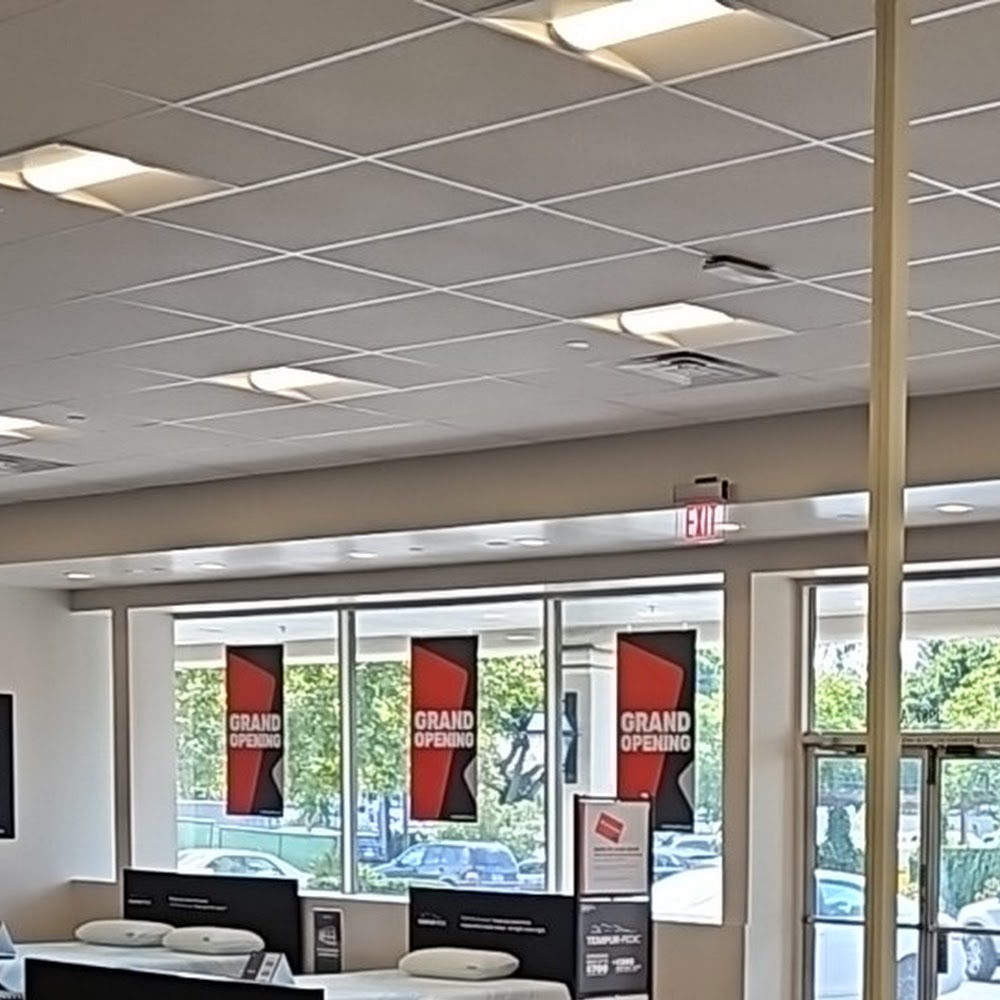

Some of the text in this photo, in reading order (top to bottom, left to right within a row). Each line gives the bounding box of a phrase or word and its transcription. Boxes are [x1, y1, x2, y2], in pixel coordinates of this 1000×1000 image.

[686, 504, 718, 538] EXIT
[229, 713, 281, 732] GRAND
[414, 711, 474, 731] GRAND
[621, 711, 692, 733] GRAND
[229, 733, 281, 748] OPENING
[414, 732, 474, 749] OPENING
[621, 734, 692, 753] OPENING
